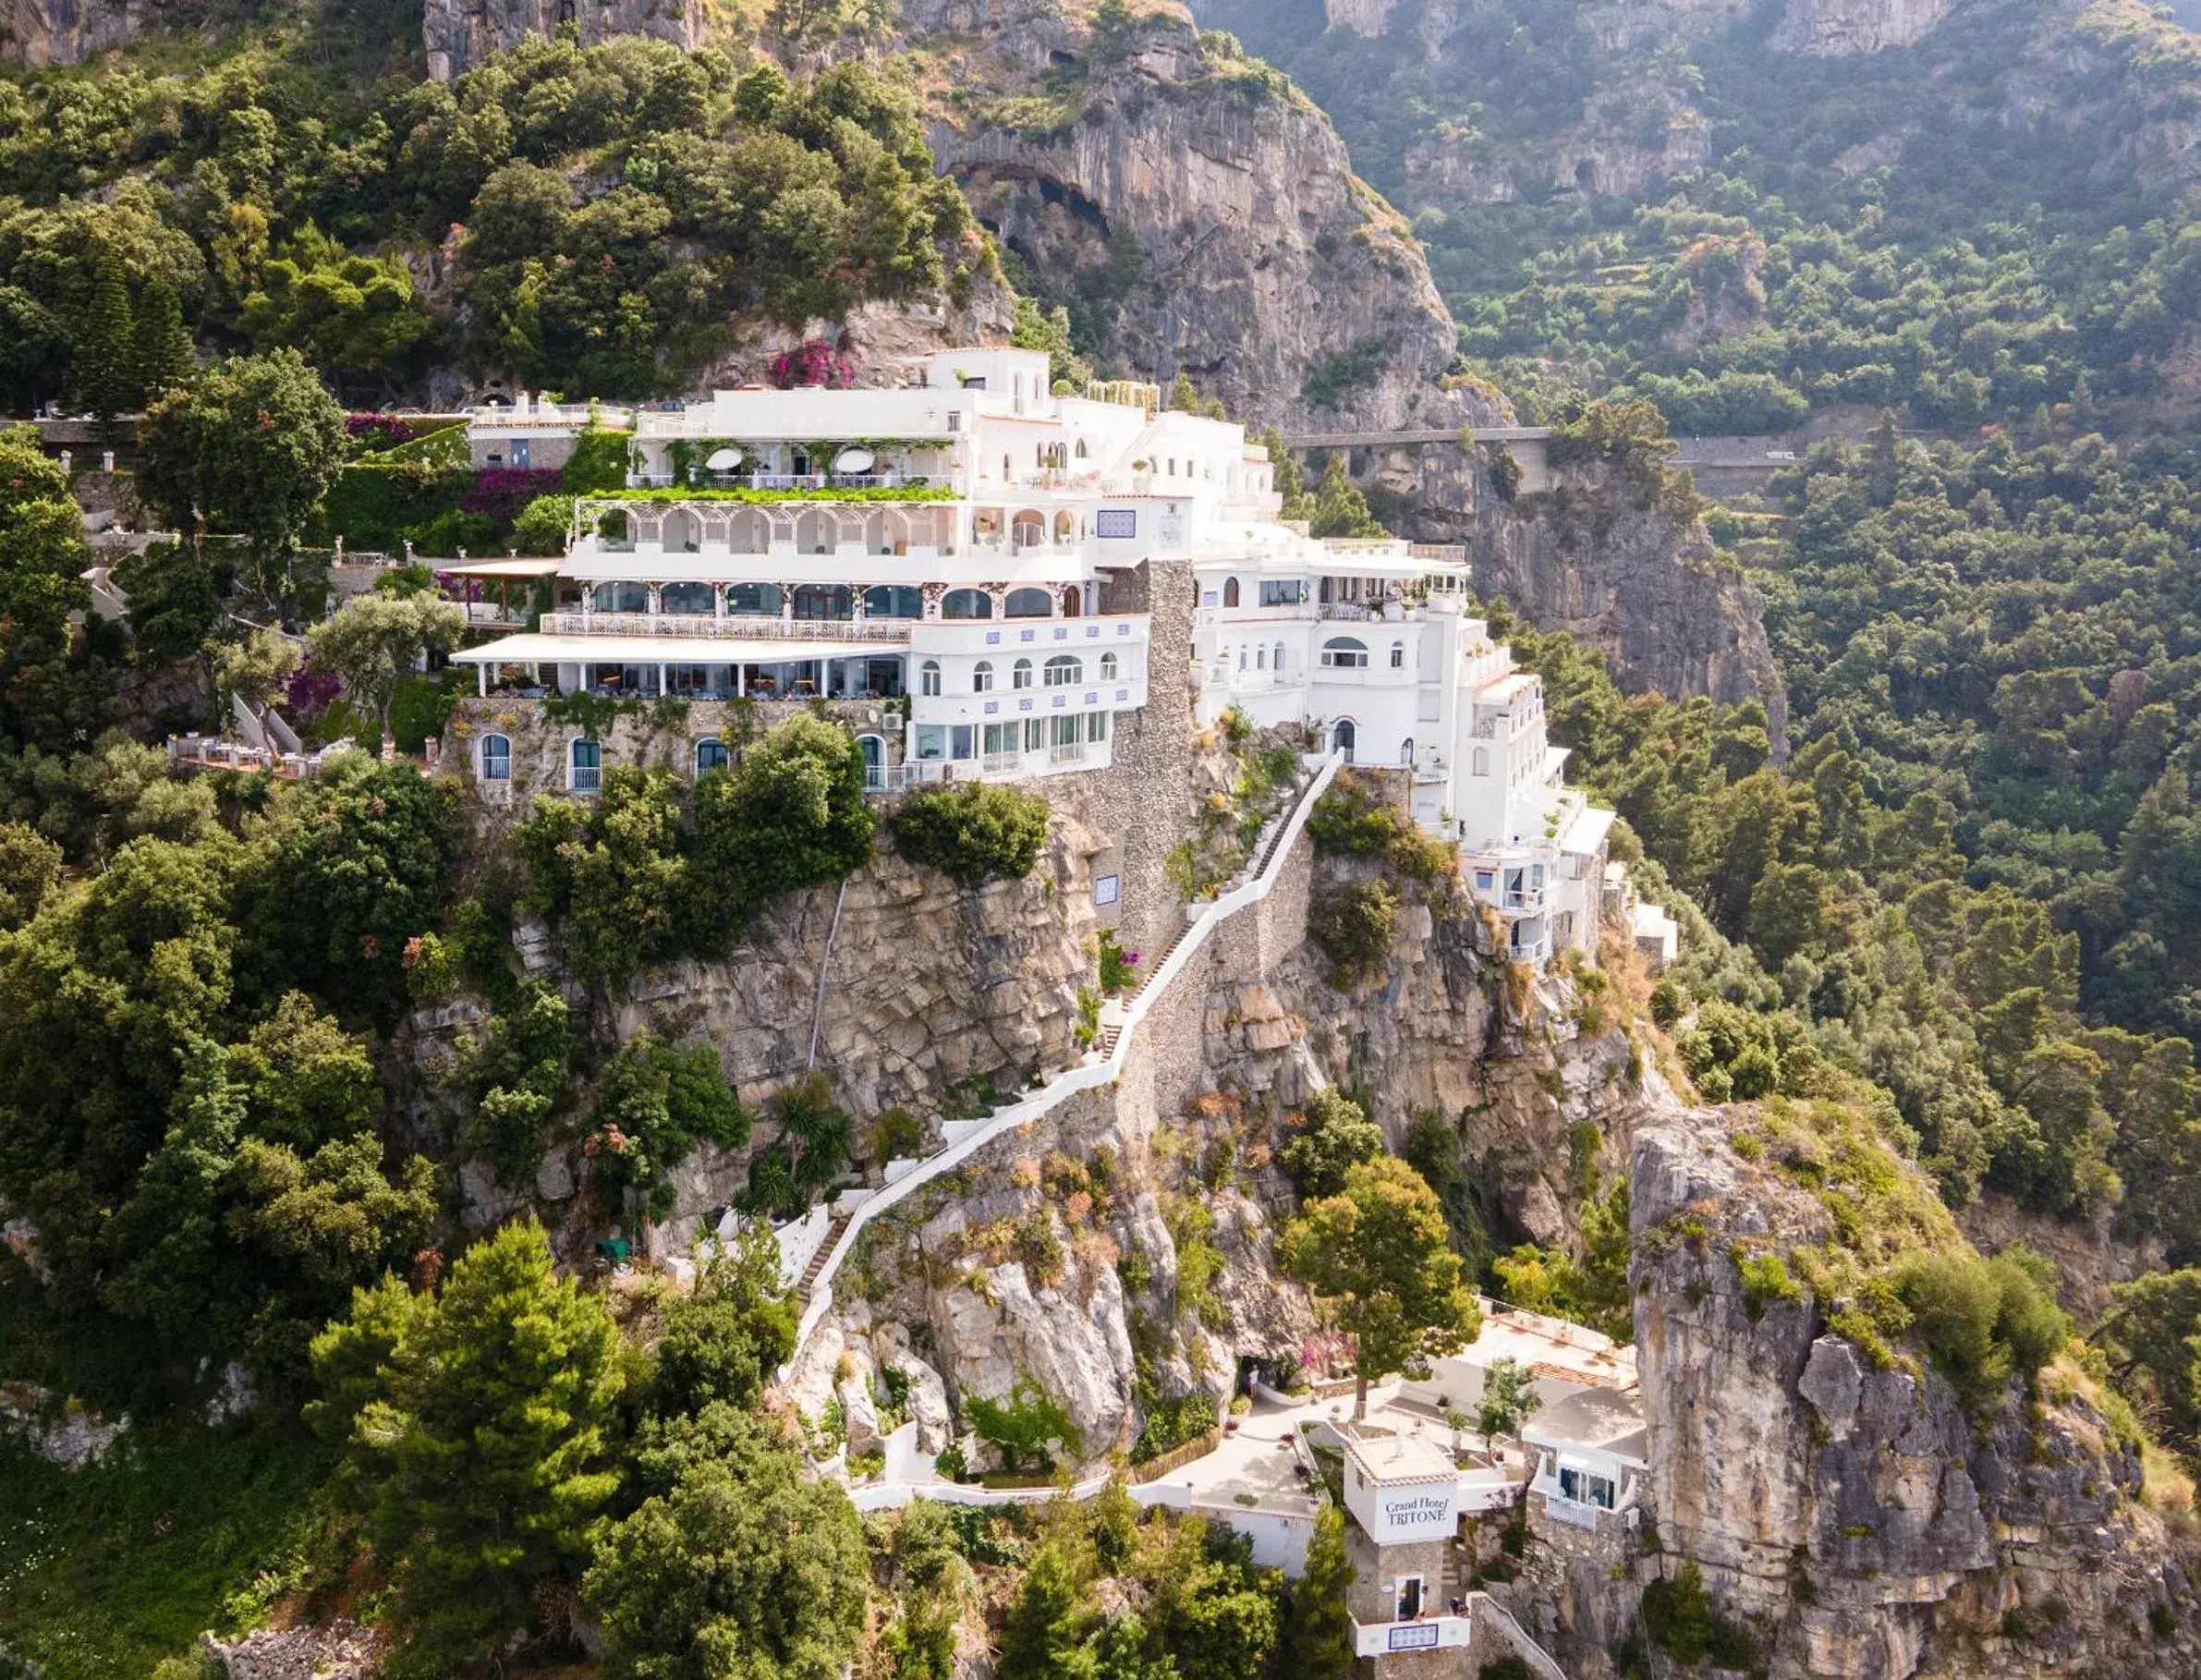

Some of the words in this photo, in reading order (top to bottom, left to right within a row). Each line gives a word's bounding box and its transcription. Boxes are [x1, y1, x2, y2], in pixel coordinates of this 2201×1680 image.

[1386, 1499, 1417, 1514] Grand
[1419, 1497, 1449, 1510] Hotel
[1389, 1510, 1446, 1526] TRITONE
